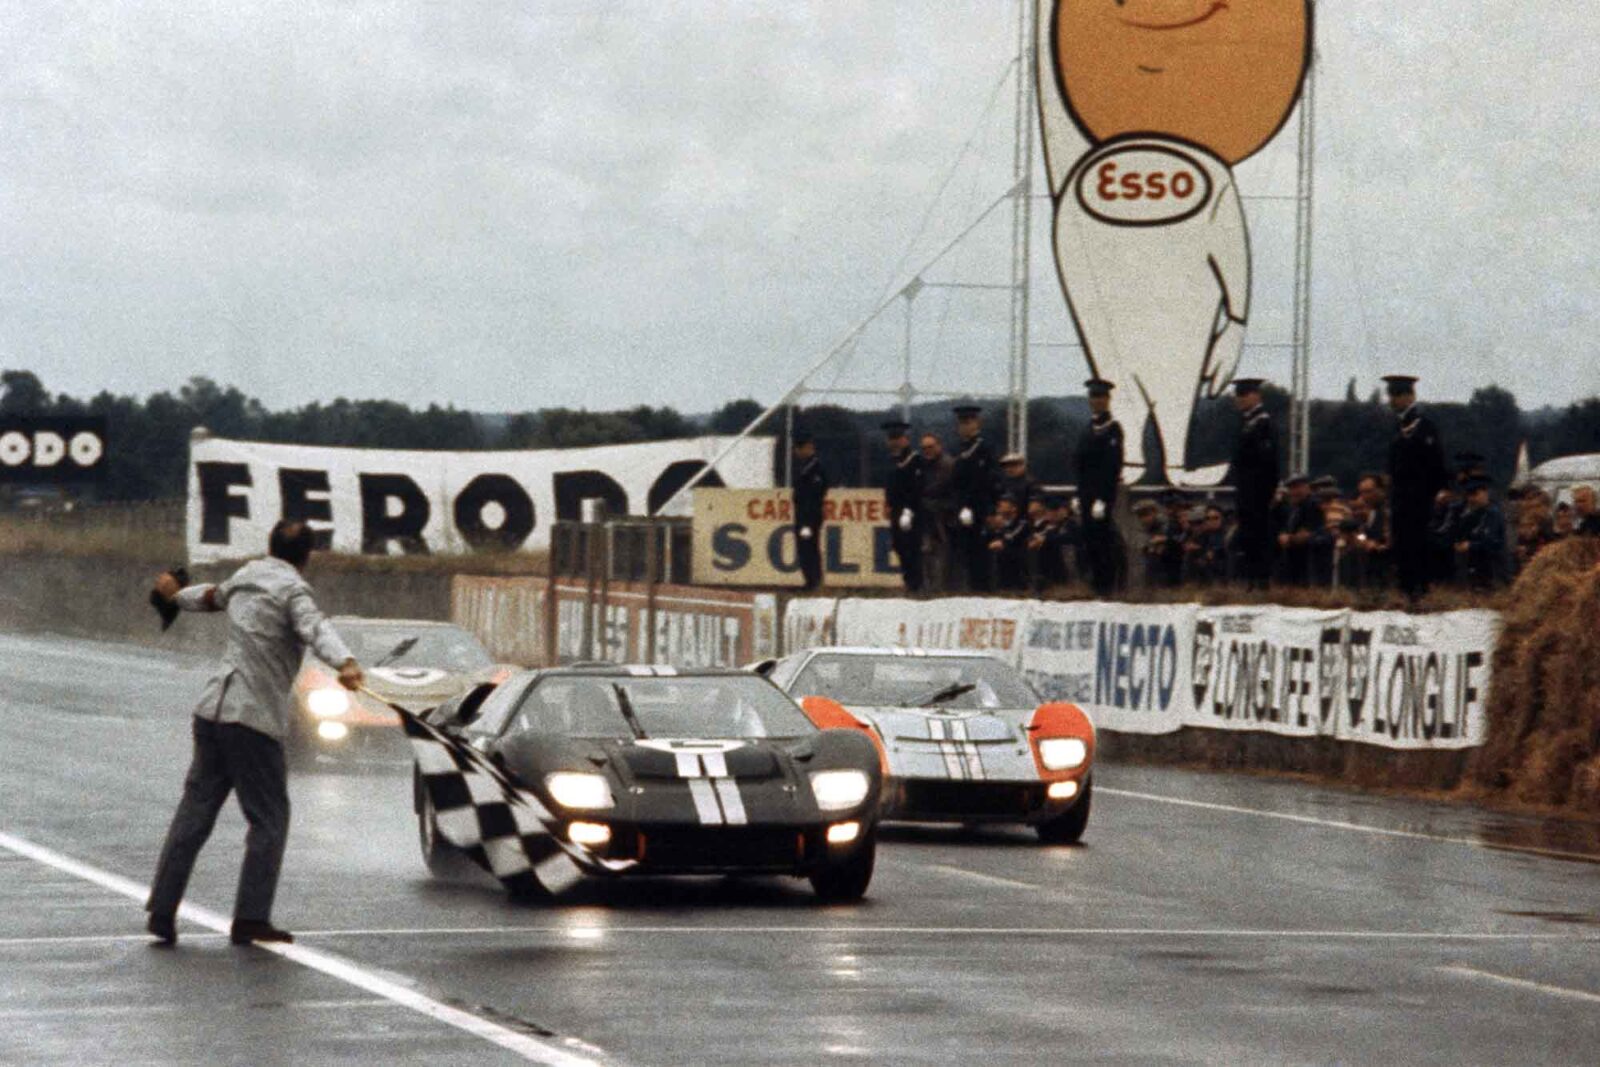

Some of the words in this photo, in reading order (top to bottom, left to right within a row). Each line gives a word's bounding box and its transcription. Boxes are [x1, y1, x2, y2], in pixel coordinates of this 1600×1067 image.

[1097, 162, 1195, 201] Esso
[0, 431, 102, 467] ODO
[1095, 621, 1176, 711] NECTO
[1213, 640, 1313, 727] LONGLIFE
